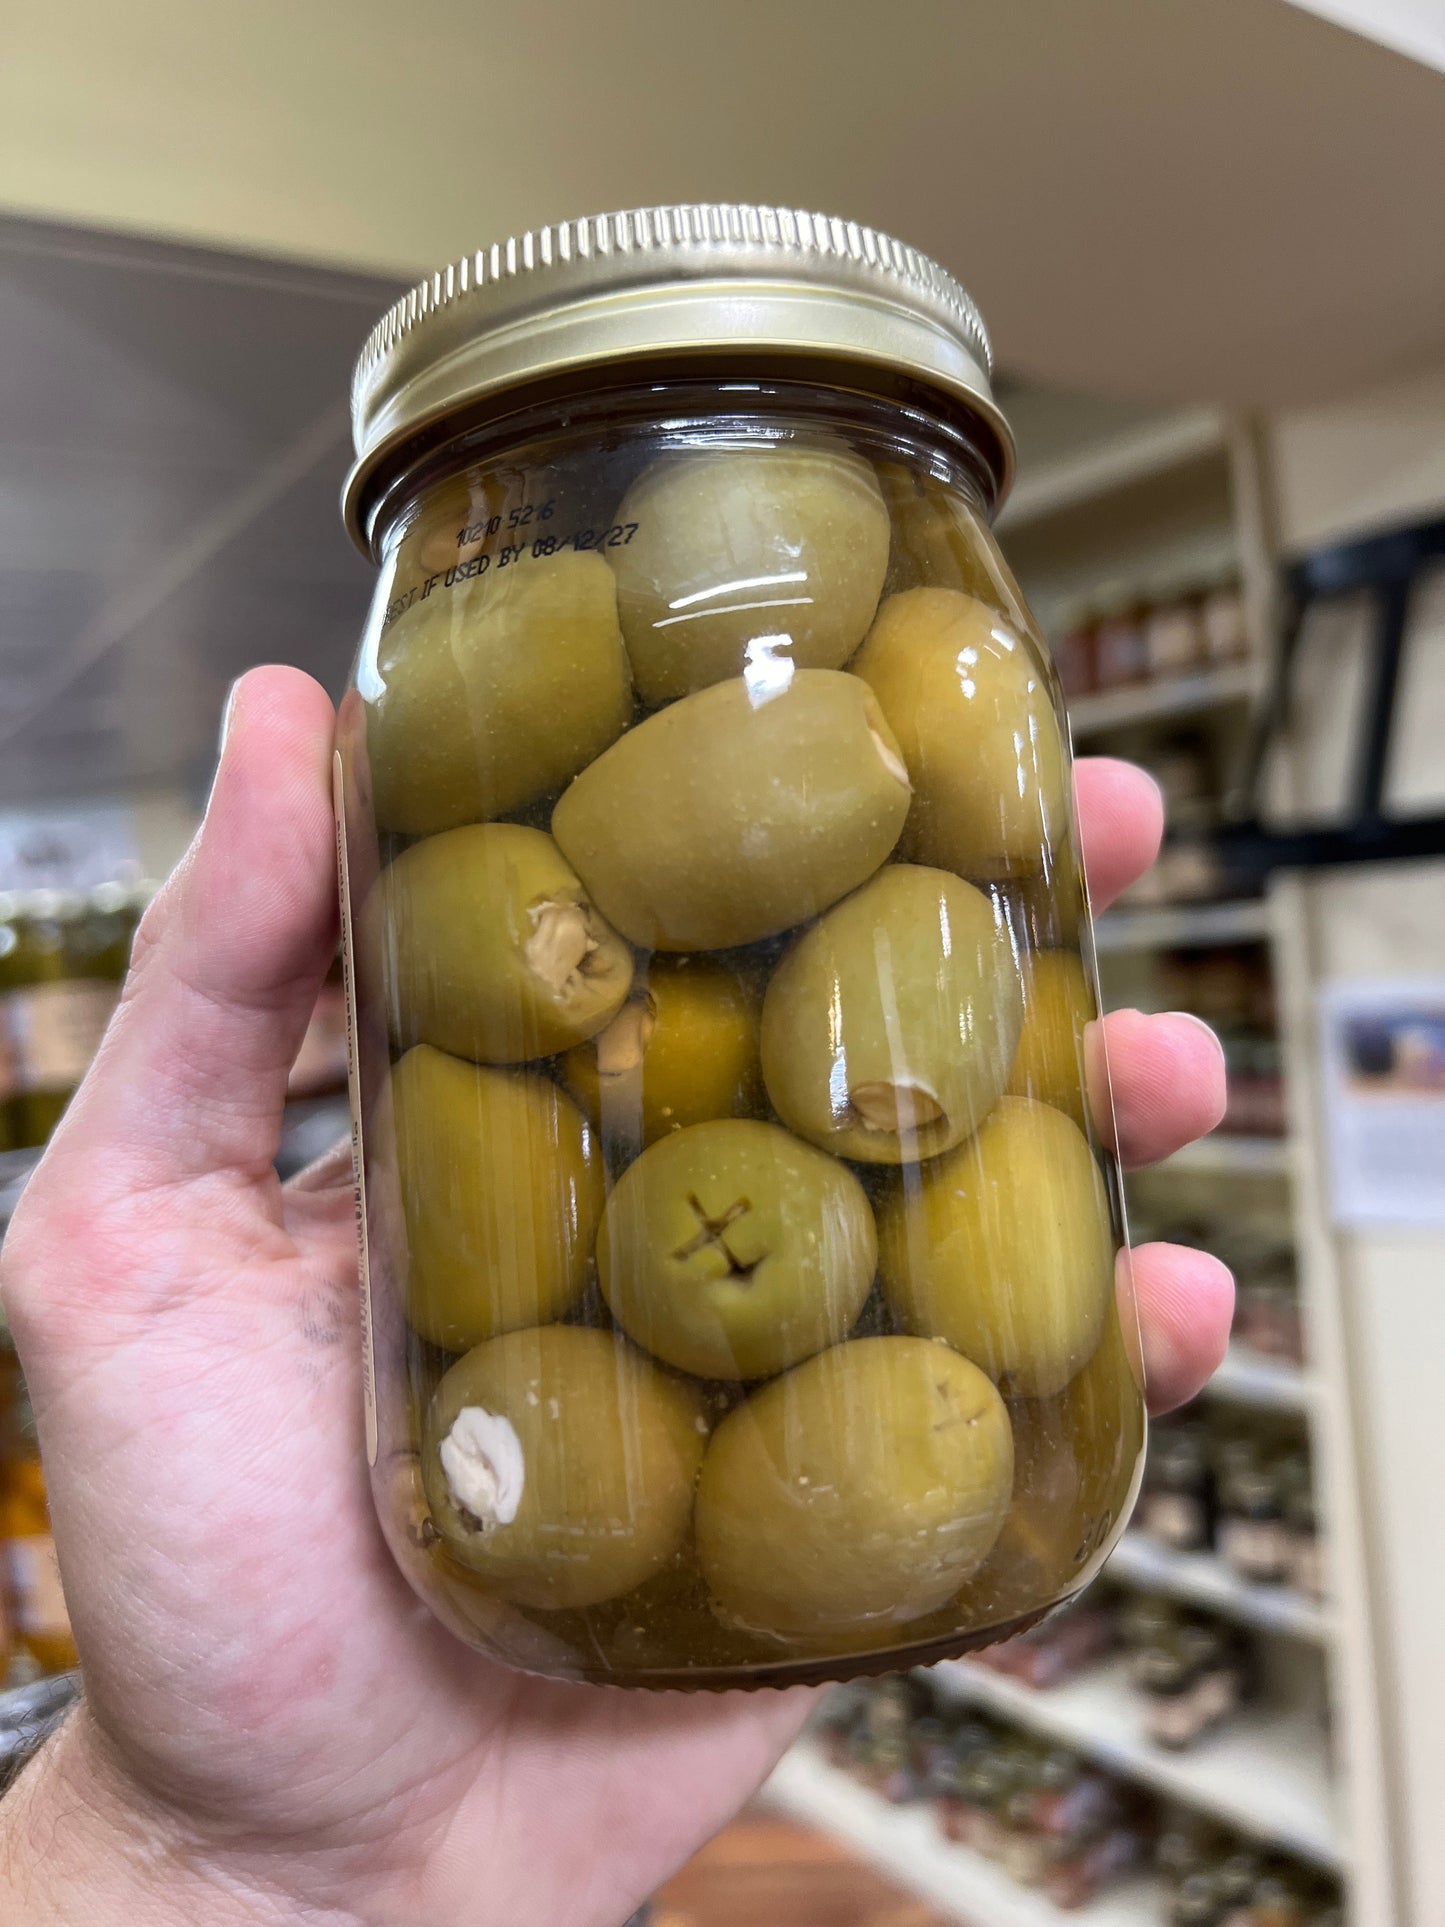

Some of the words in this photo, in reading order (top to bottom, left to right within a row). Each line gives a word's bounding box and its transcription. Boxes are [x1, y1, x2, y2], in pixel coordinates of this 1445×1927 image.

[456, 515, 502, 548] 10210
[420, 574, 441, 601] IF
[444, 554, 491, 588] USED
[497, 542, 527, 569] BY
